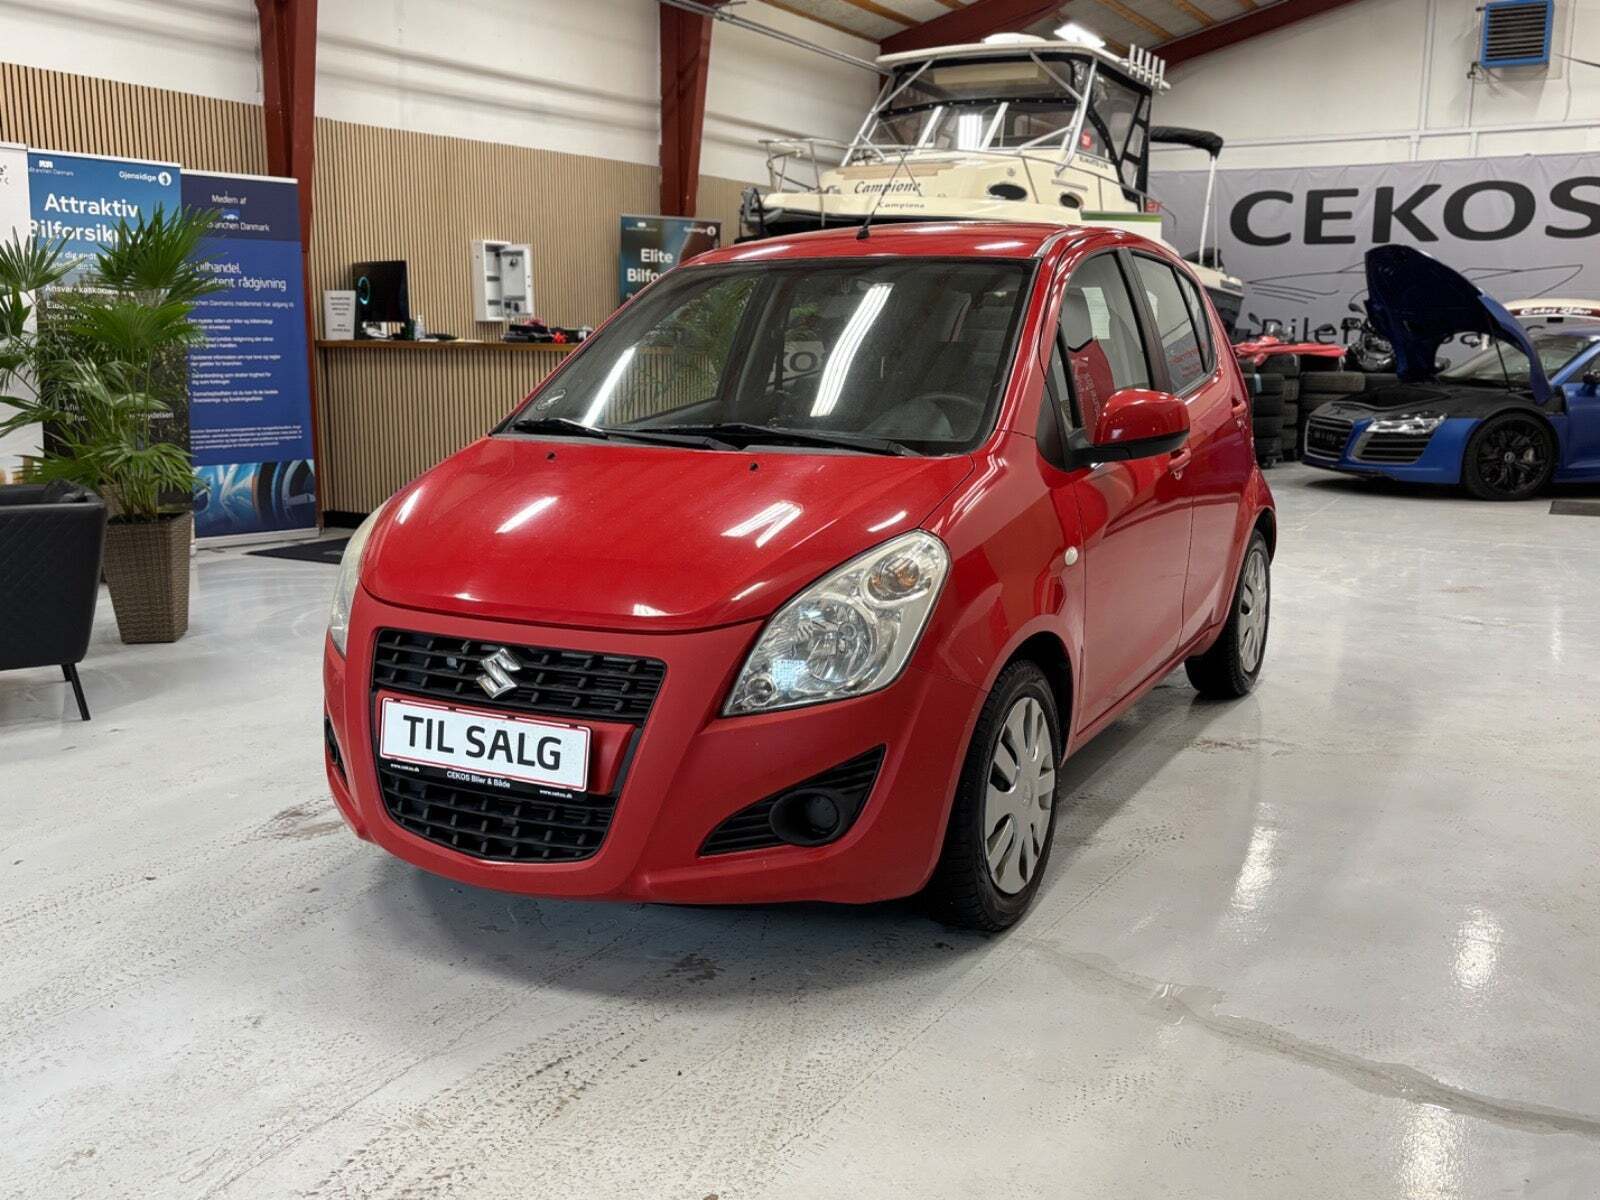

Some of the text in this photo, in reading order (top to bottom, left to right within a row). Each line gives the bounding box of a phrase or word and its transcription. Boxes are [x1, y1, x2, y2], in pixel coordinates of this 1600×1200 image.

[119, 170, 157, 182] Gjensidige
[854, 180, 921, 196] Campione
[44, 193, 138, 218] Attraktiv
[211, 193, 238, 204] Medlem
[1230, 177, 1600, 246] CEKOS
[240, 222, 270, 232] Danmark
[640, 248, 673, 263] Elite
[627, 268, 663, 282] Bilfo
[238, 276, 287, 292] rådgivning
[403, 715, 562, 771] TIL SALG
[446, 770, 470, 782] CEKOS
[493, 778, 511, 789] Både
